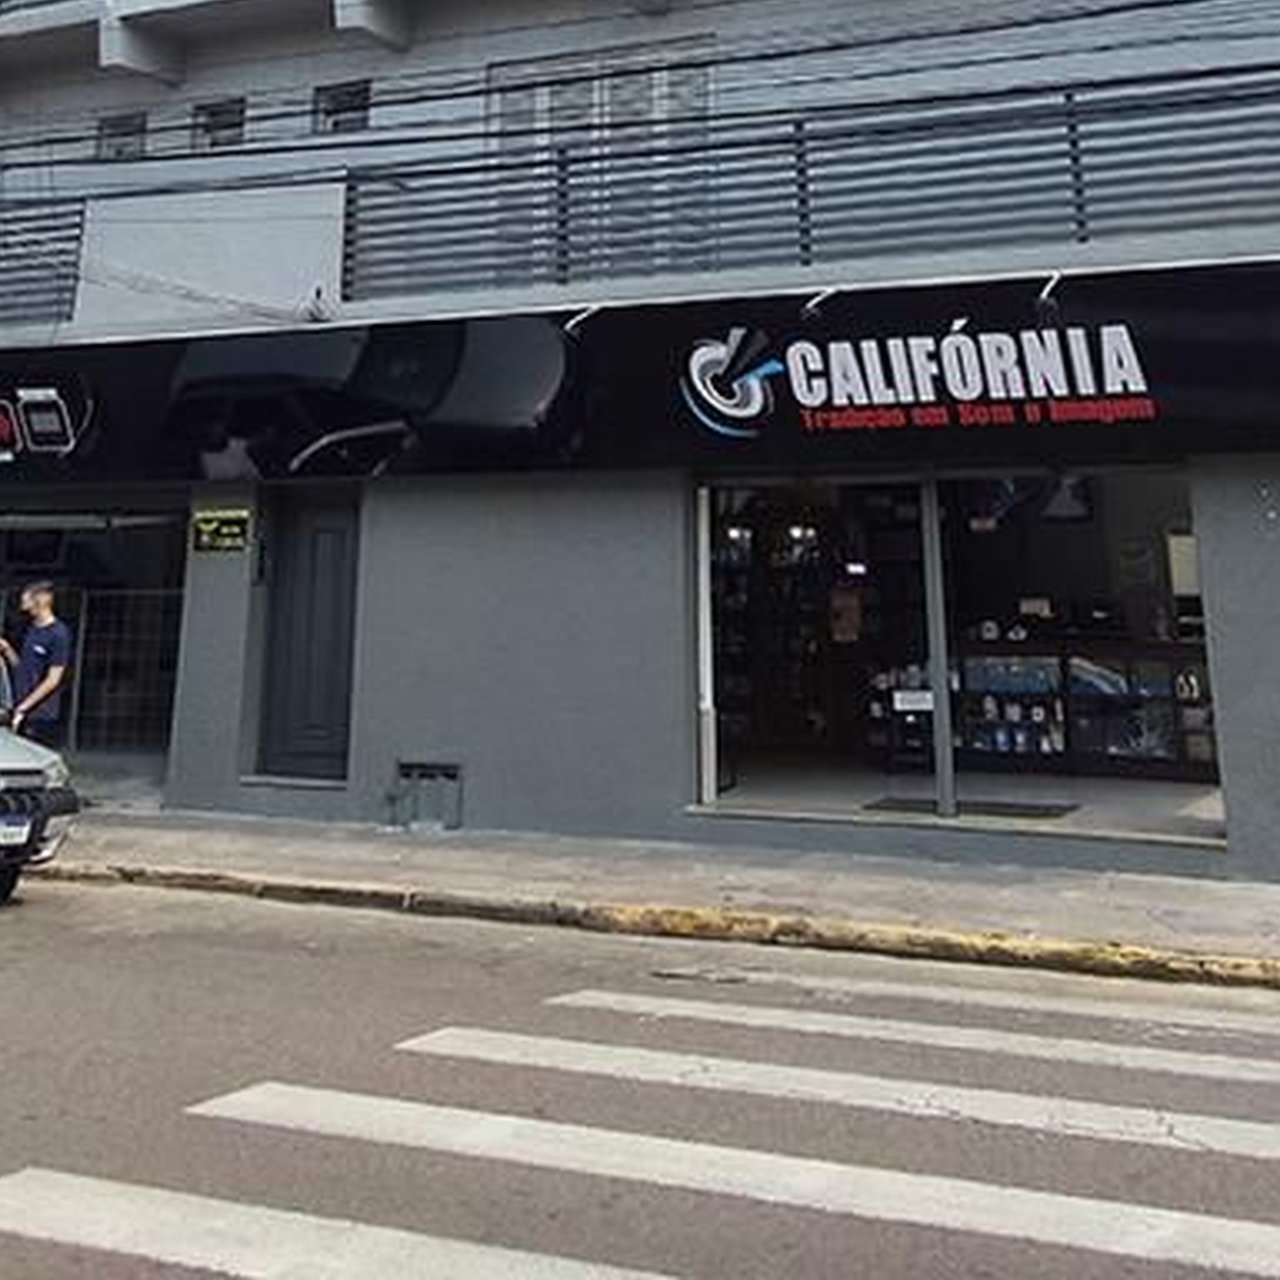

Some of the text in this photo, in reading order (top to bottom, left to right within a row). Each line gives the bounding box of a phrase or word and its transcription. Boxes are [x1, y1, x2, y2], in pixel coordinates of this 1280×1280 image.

[786, 317, 1148, 407] CALIFÓRNIA
[958, 402, 1015, 426] Som
[1050, 396, 1156, 423] Imagem
